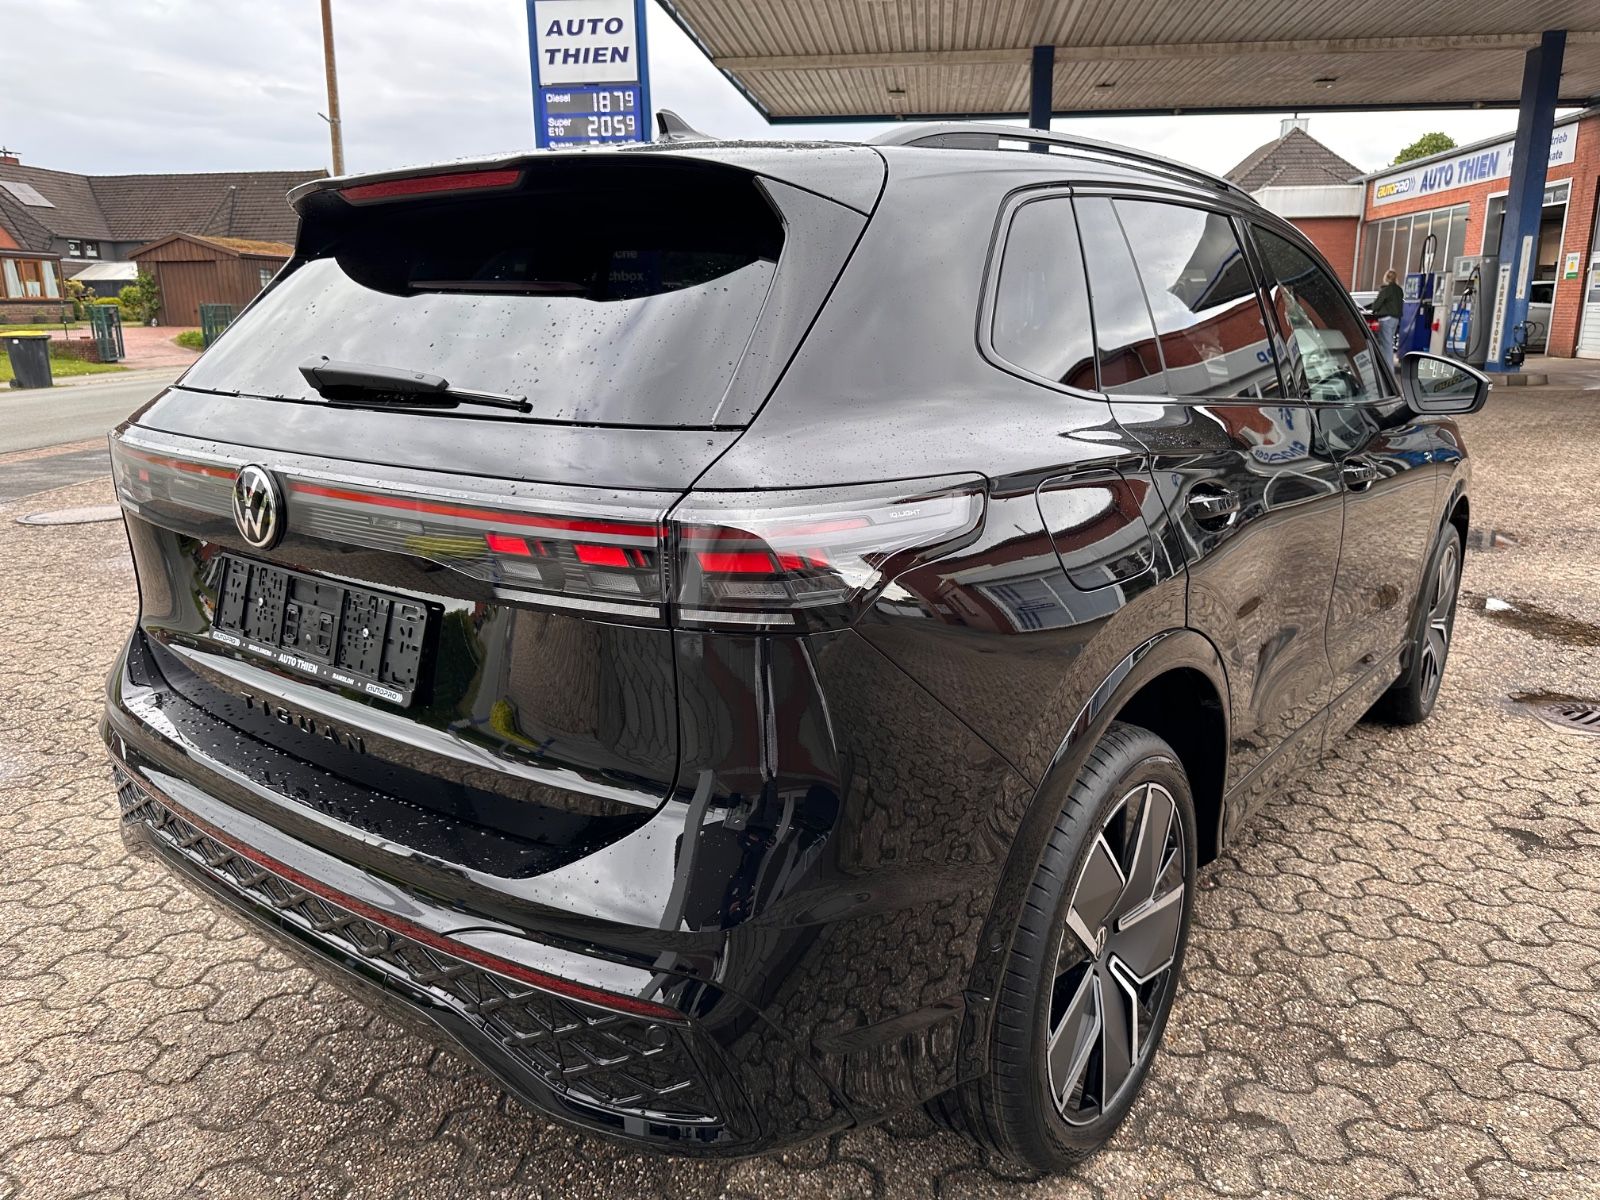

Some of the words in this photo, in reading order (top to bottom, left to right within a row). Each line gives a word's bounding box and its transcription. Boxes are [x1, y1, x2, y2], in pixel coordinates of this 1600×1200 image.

[545, 17, 624, 37] AUTO
[544, 46, 630, 65] THIEN
[545, 93, 571, 103] Diesel
[547, 117, 572, 127] Super
[548, 127, 565, 136] E10
[1419, 163, 1454, 193] AUTO
[1457, 151, 1500, 184] THIEN
[278, 653, 297, 667] AUTO
[297, 659, 319, 675] THIEN
[240, 691, 366, 754] TIGUAN
